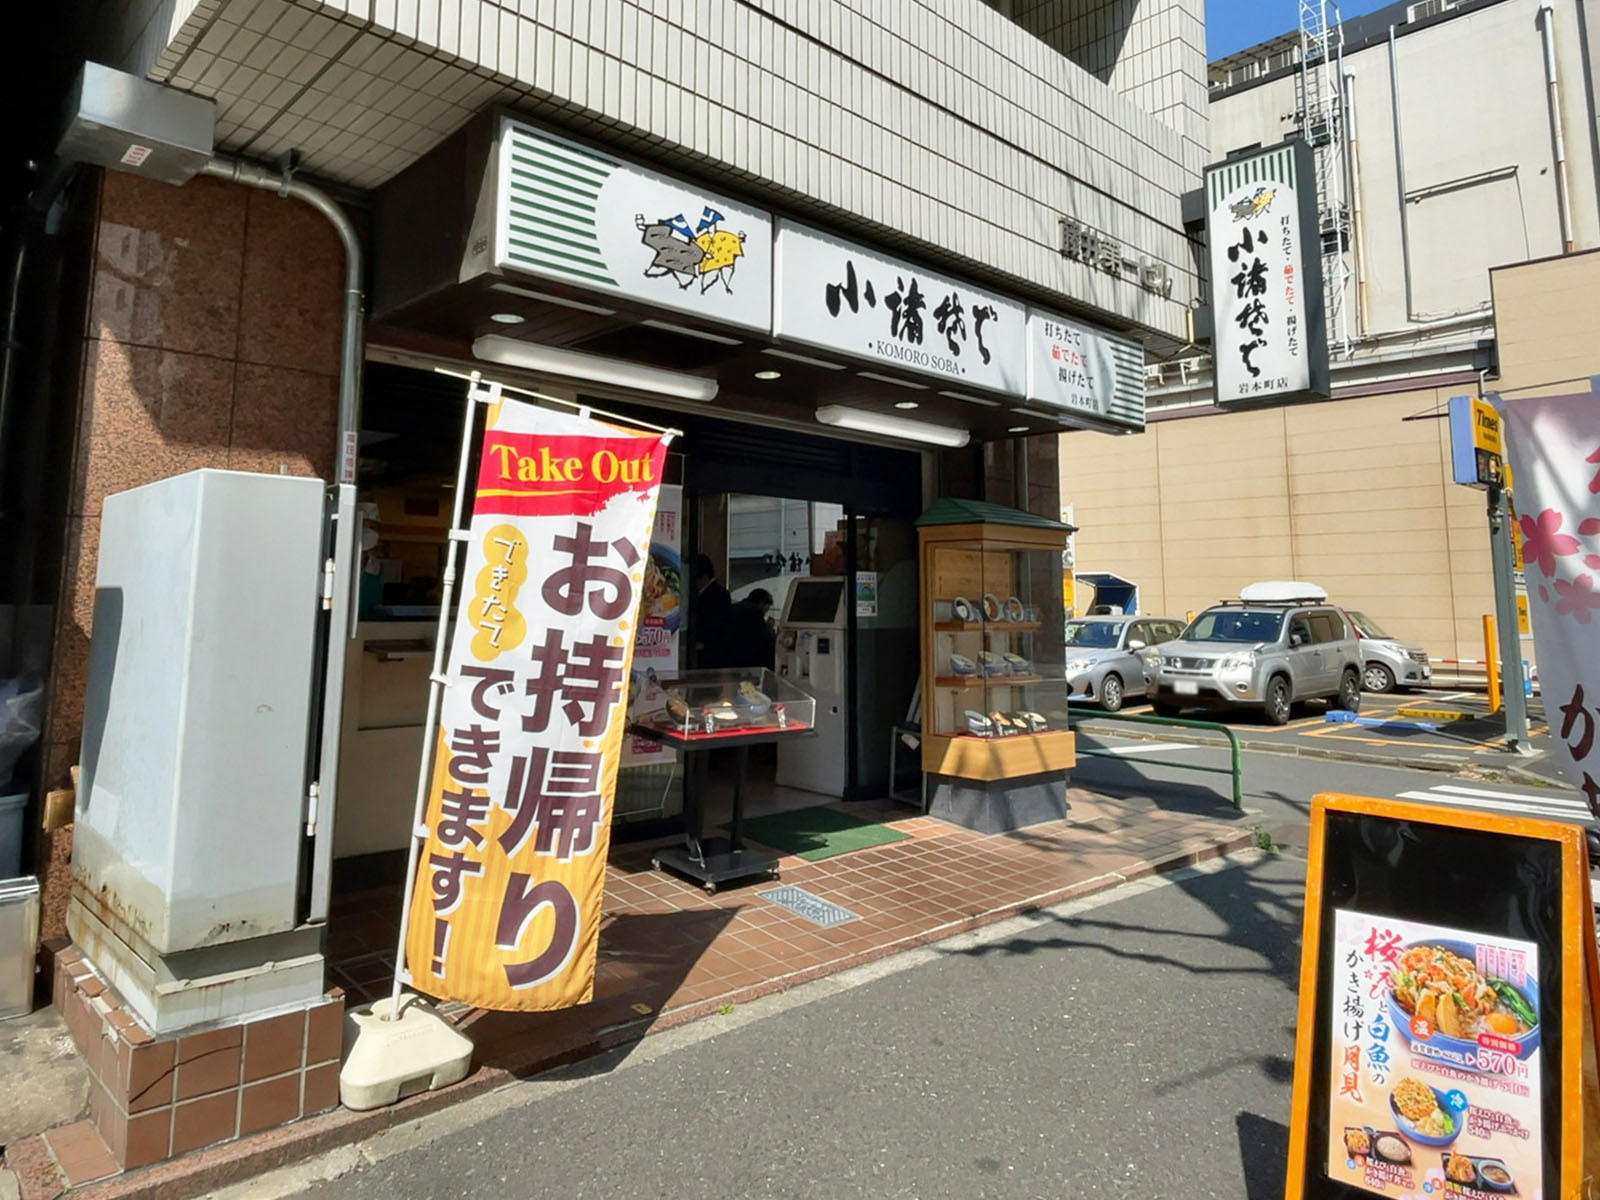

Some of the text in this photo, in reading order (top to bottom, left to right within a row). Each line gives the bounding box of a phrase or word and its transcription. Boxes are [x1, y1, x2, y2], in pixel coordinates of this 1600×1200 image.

[1045, 321, 1080, 346] 打ちたて
[877, 342, 960, 375] KOMORO SOBA
[1239, 377, 1288, 393] 岩本町店
[490, 444, 655, 484] Take Out
[481, 537, 520, 648] できたて
[495, 521, 641, 988] お持帰り
[1341, 949, 1364, 1103] かき揚げ月見
[1479, 1050, 1528, 1078] 570円
